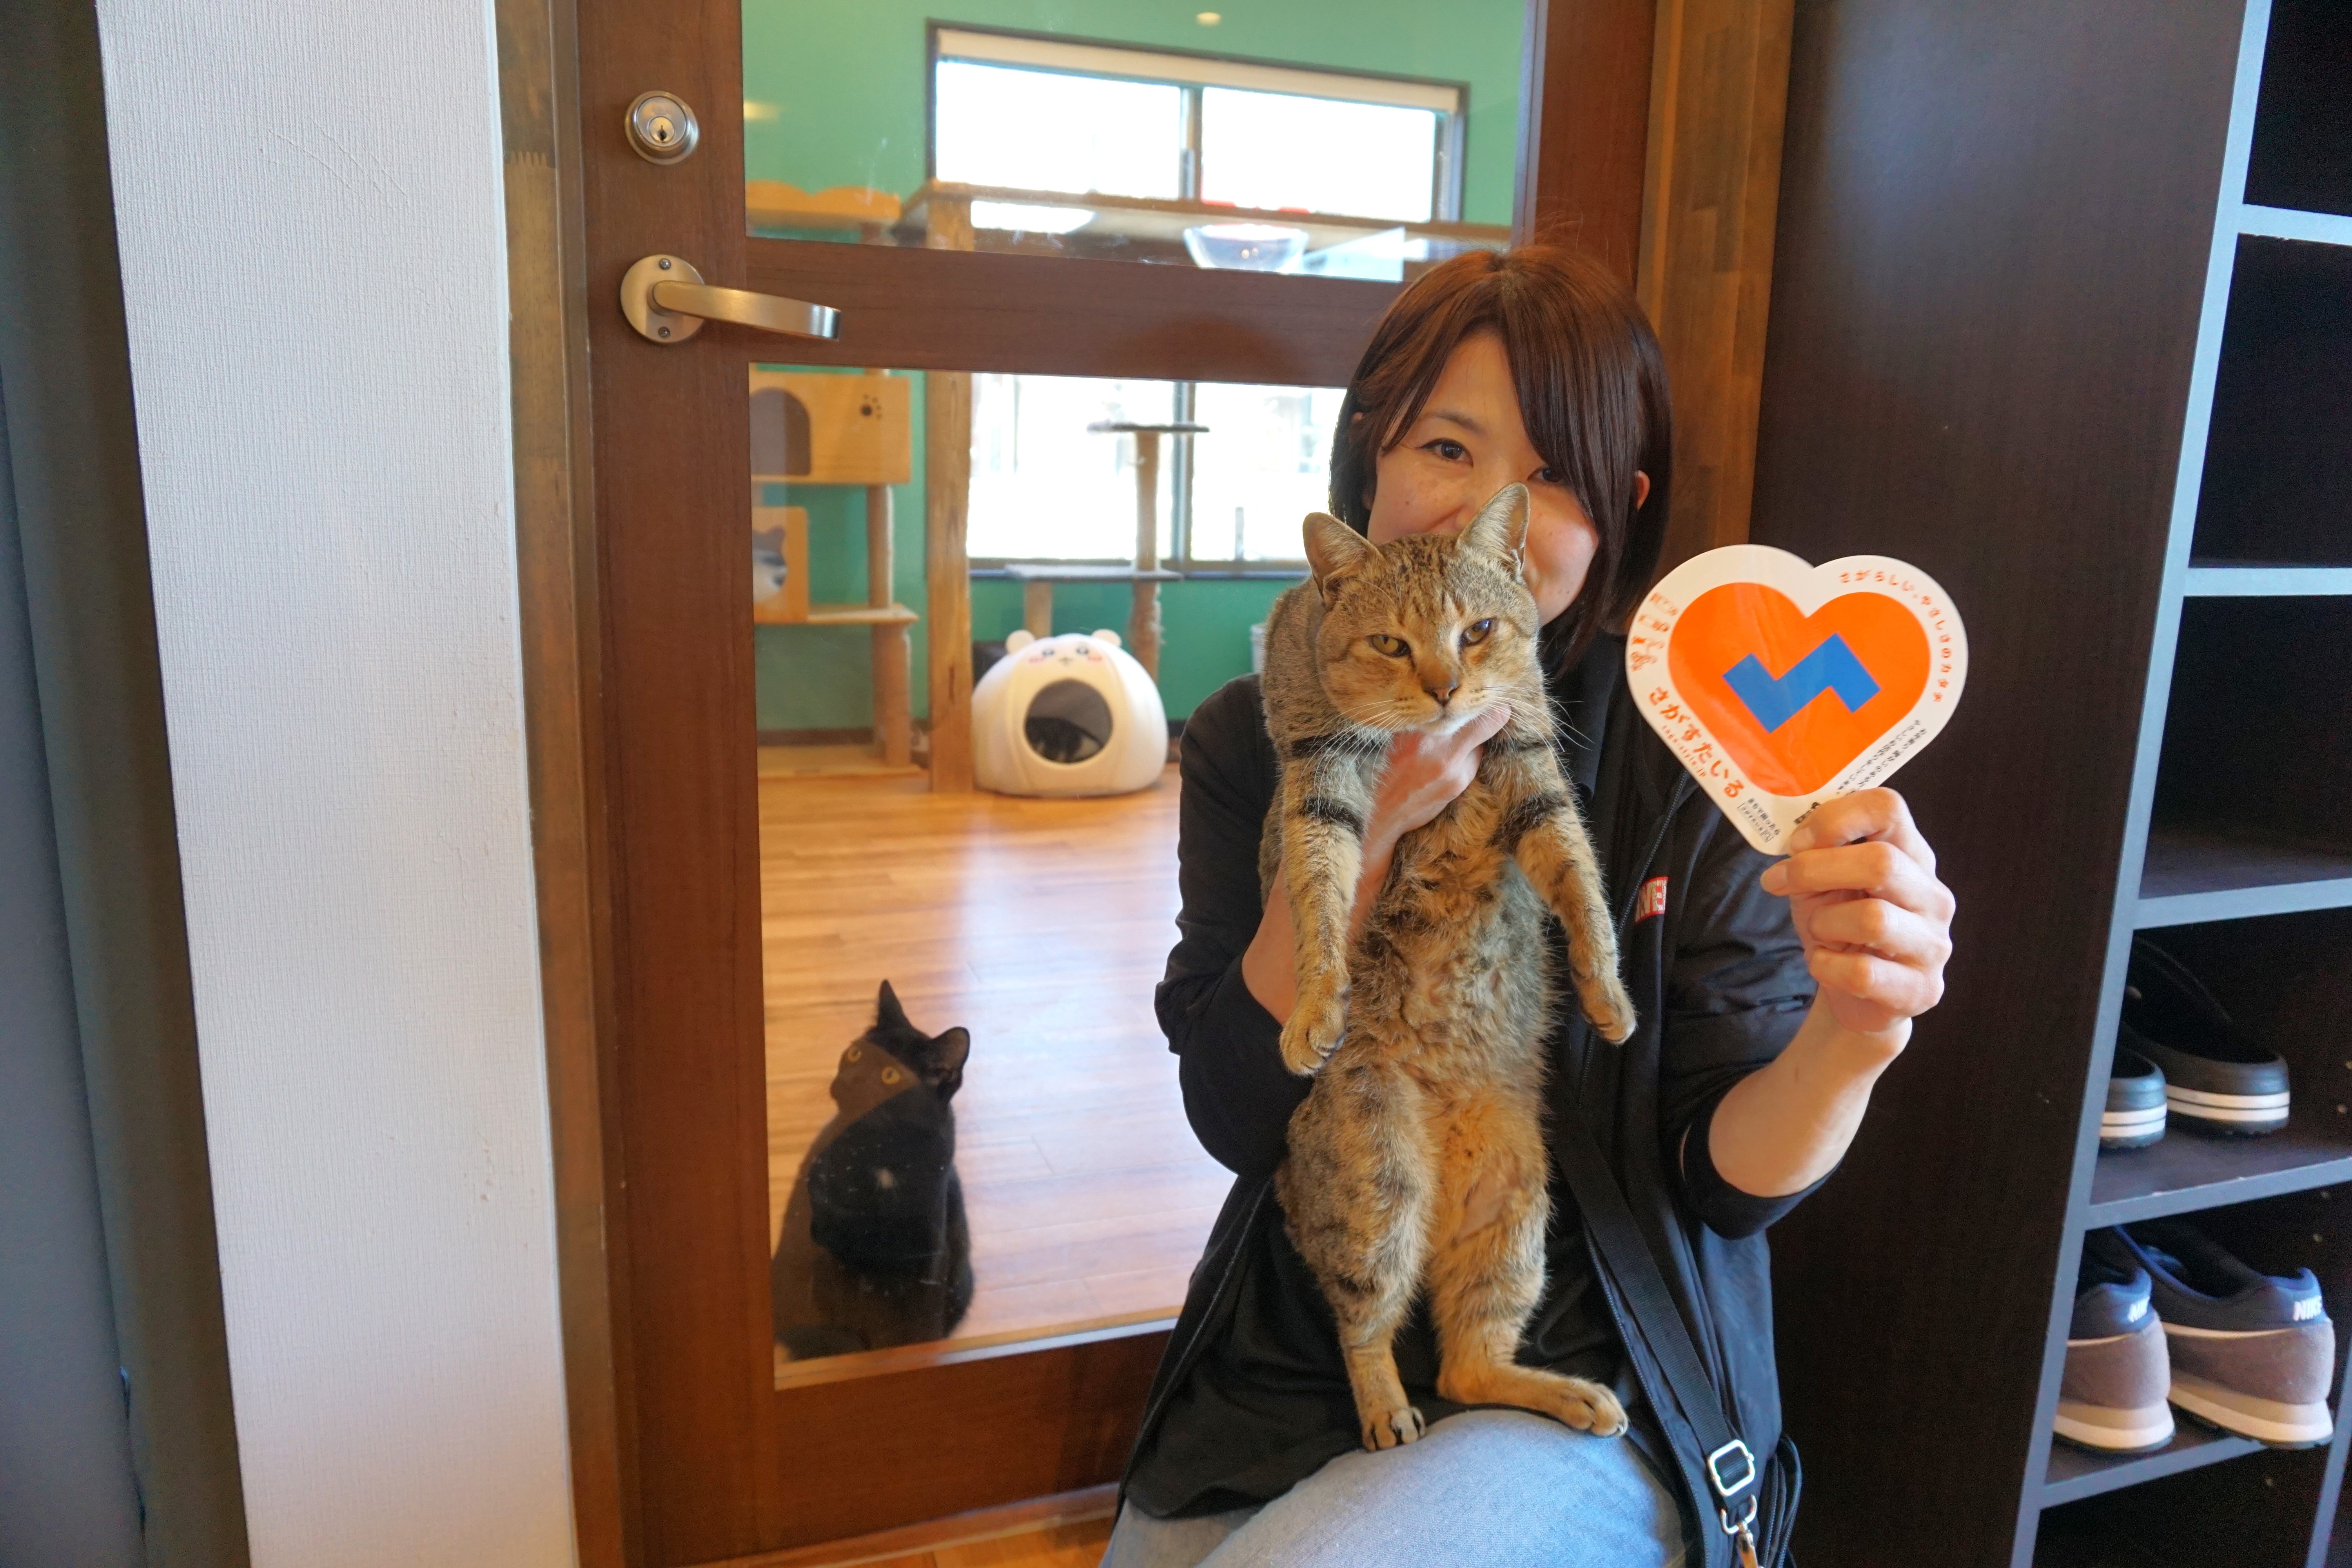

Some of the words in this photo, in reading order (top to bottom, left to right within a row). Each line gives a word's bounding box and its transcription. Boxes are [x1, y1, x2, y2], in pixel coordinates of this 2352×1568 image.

[1649, 687, 1744, 798] さがすたいる
